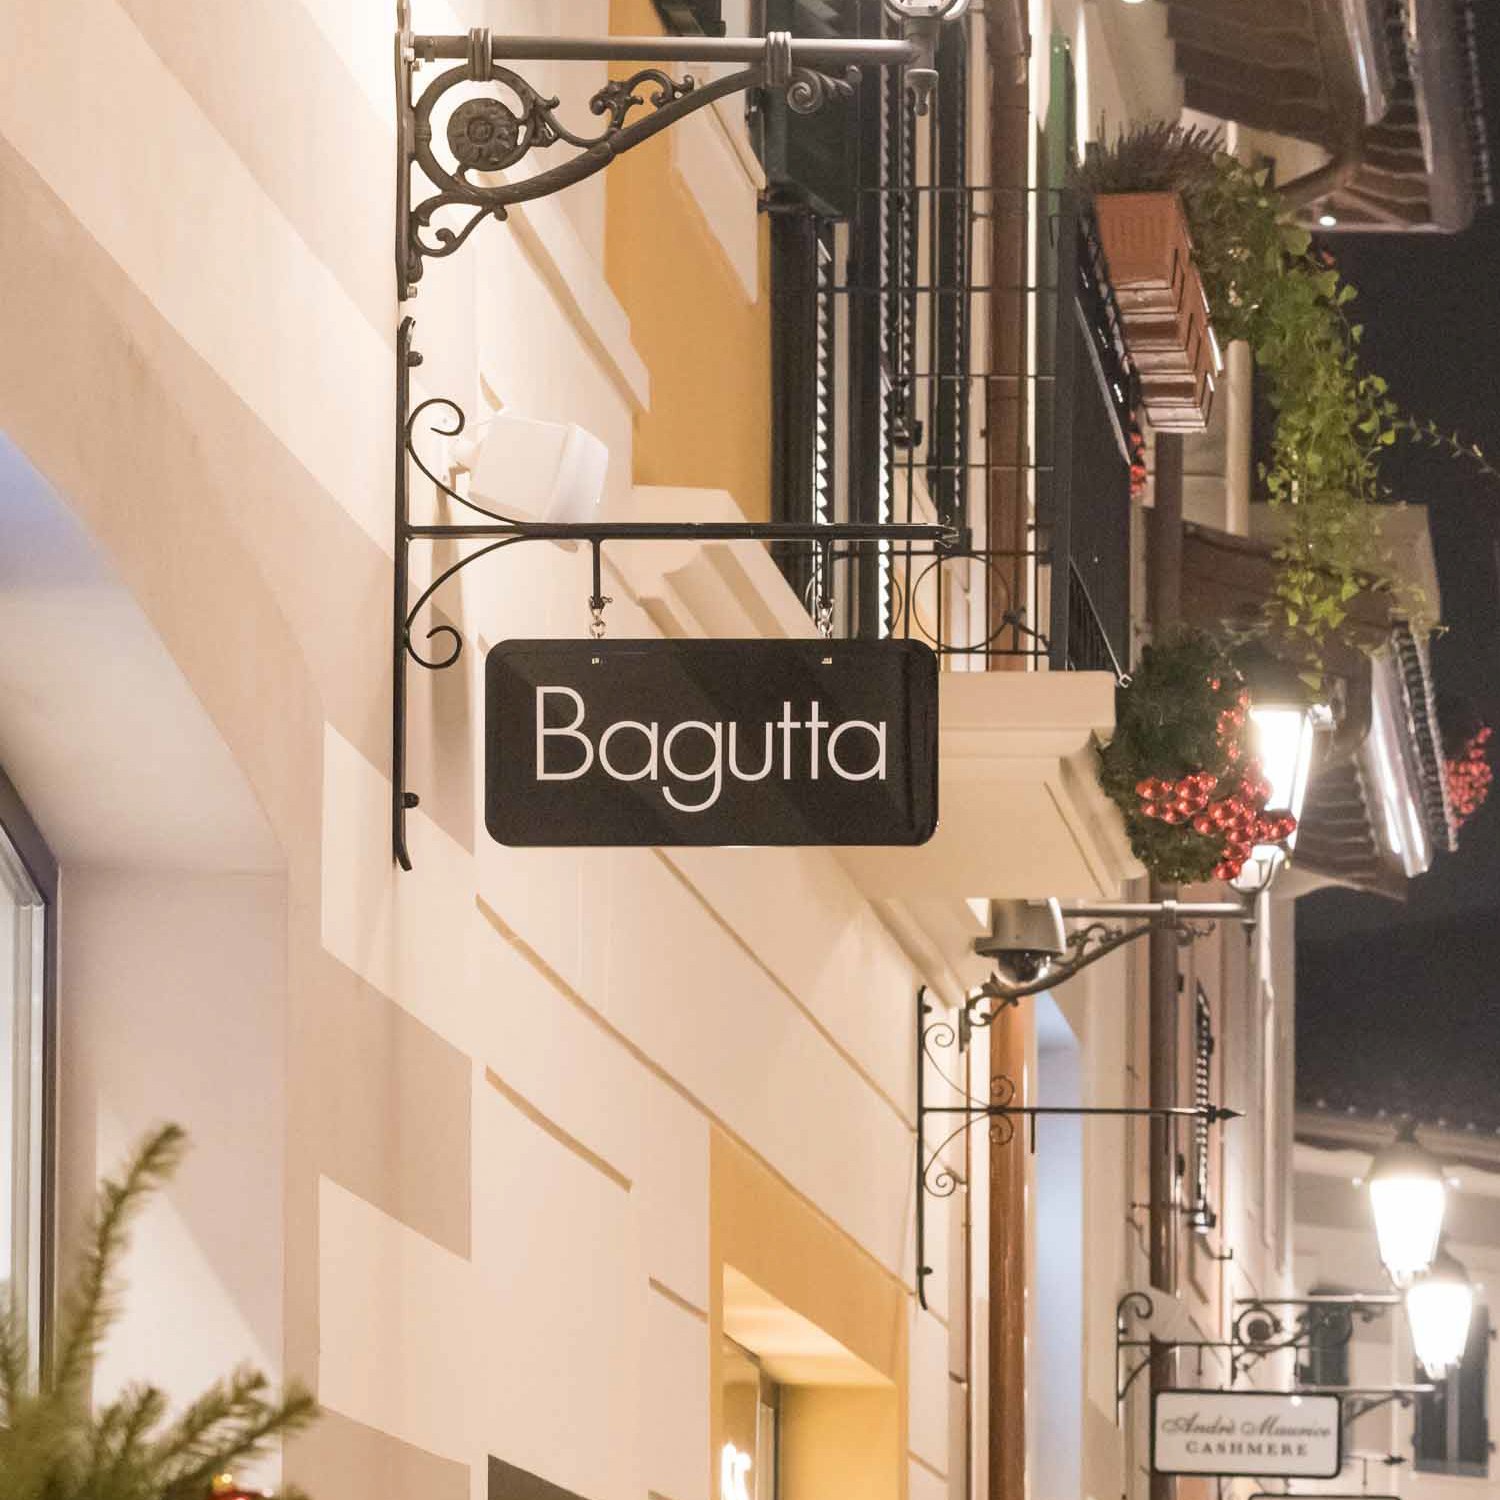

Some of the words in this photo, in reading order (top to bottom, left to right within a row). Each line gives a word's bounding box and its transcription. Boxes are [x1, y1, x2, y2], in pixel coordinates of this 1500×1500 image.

[536, 686, 887, 813] Bagutta
[1240, 1415, 1332, 1437] Maurice
[1185, 1440, 1309, 1456] CASHMERE
